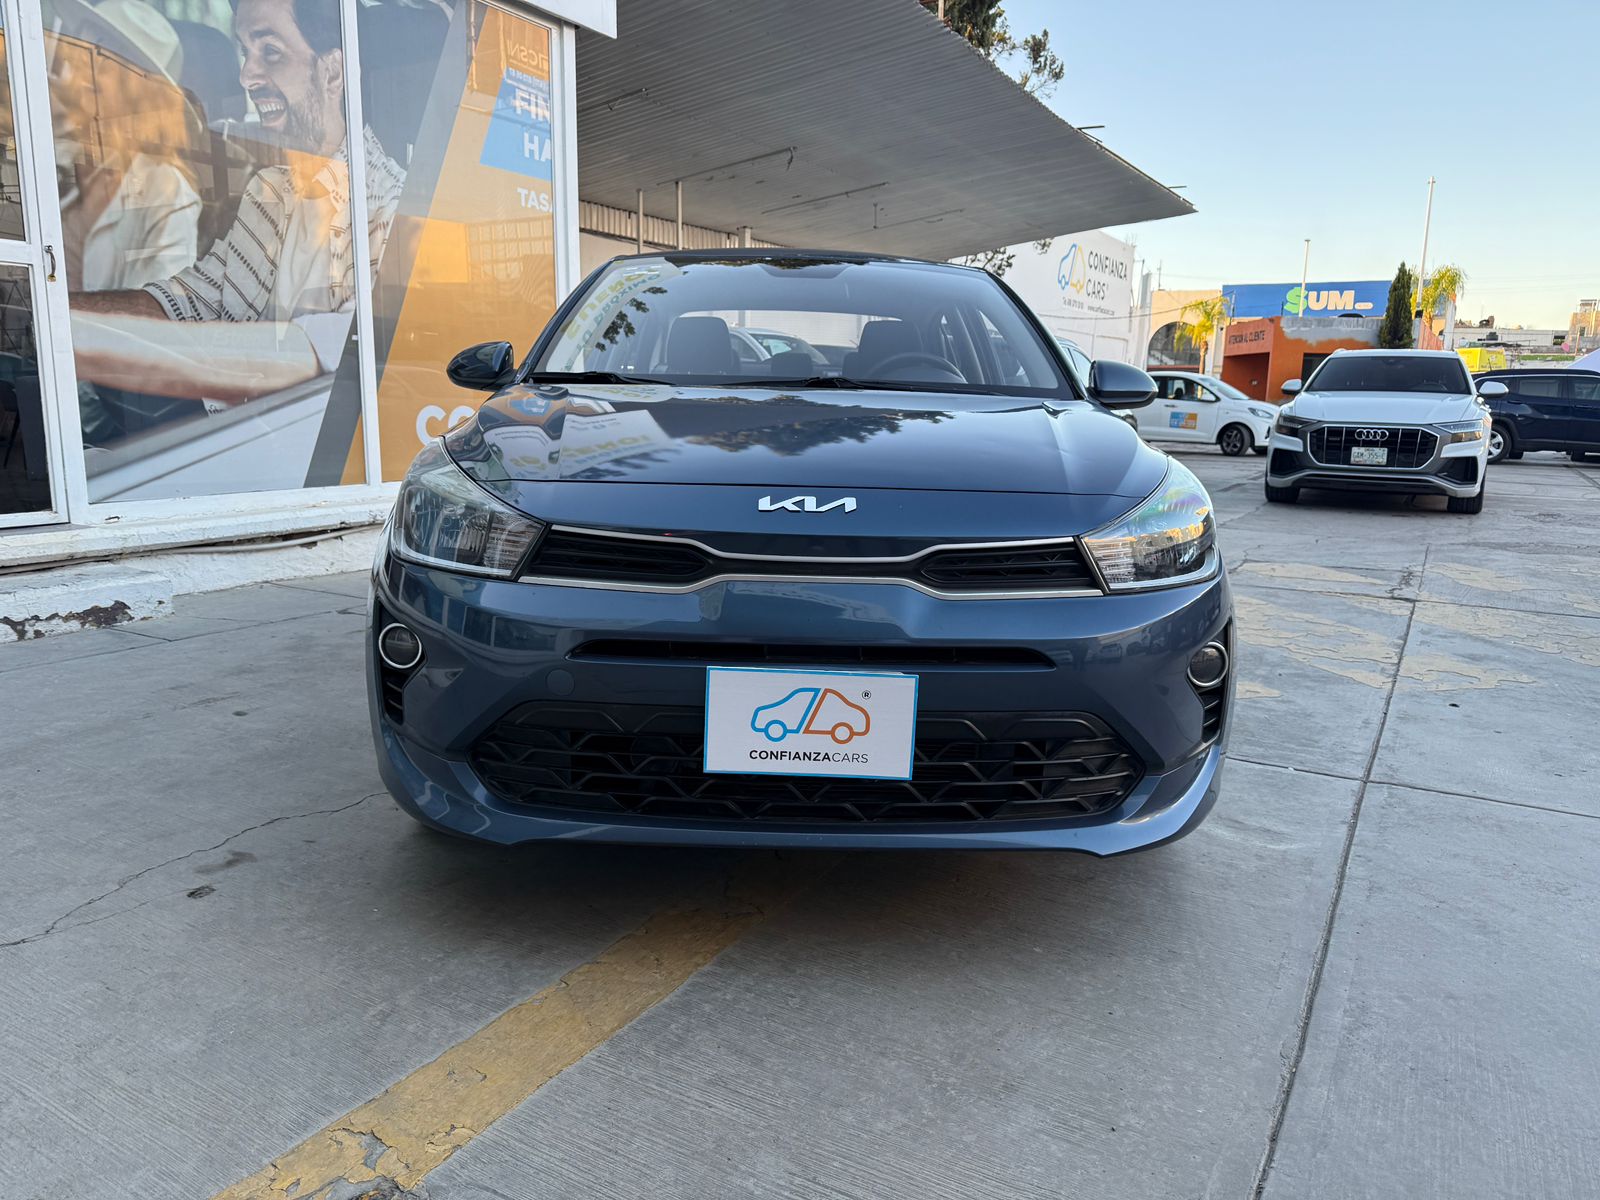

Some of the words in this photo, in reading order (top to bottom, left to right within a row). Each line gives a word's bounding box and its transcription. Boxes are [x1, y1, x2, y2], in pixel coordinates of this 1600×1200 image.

[517, 187, 552, 213] TAS
[1088, 251, 1128, 280] CONFIANZA
[1086, 278, 1106, 301] CARS
[749, 749, 869, 764] CONFIANZACARS
